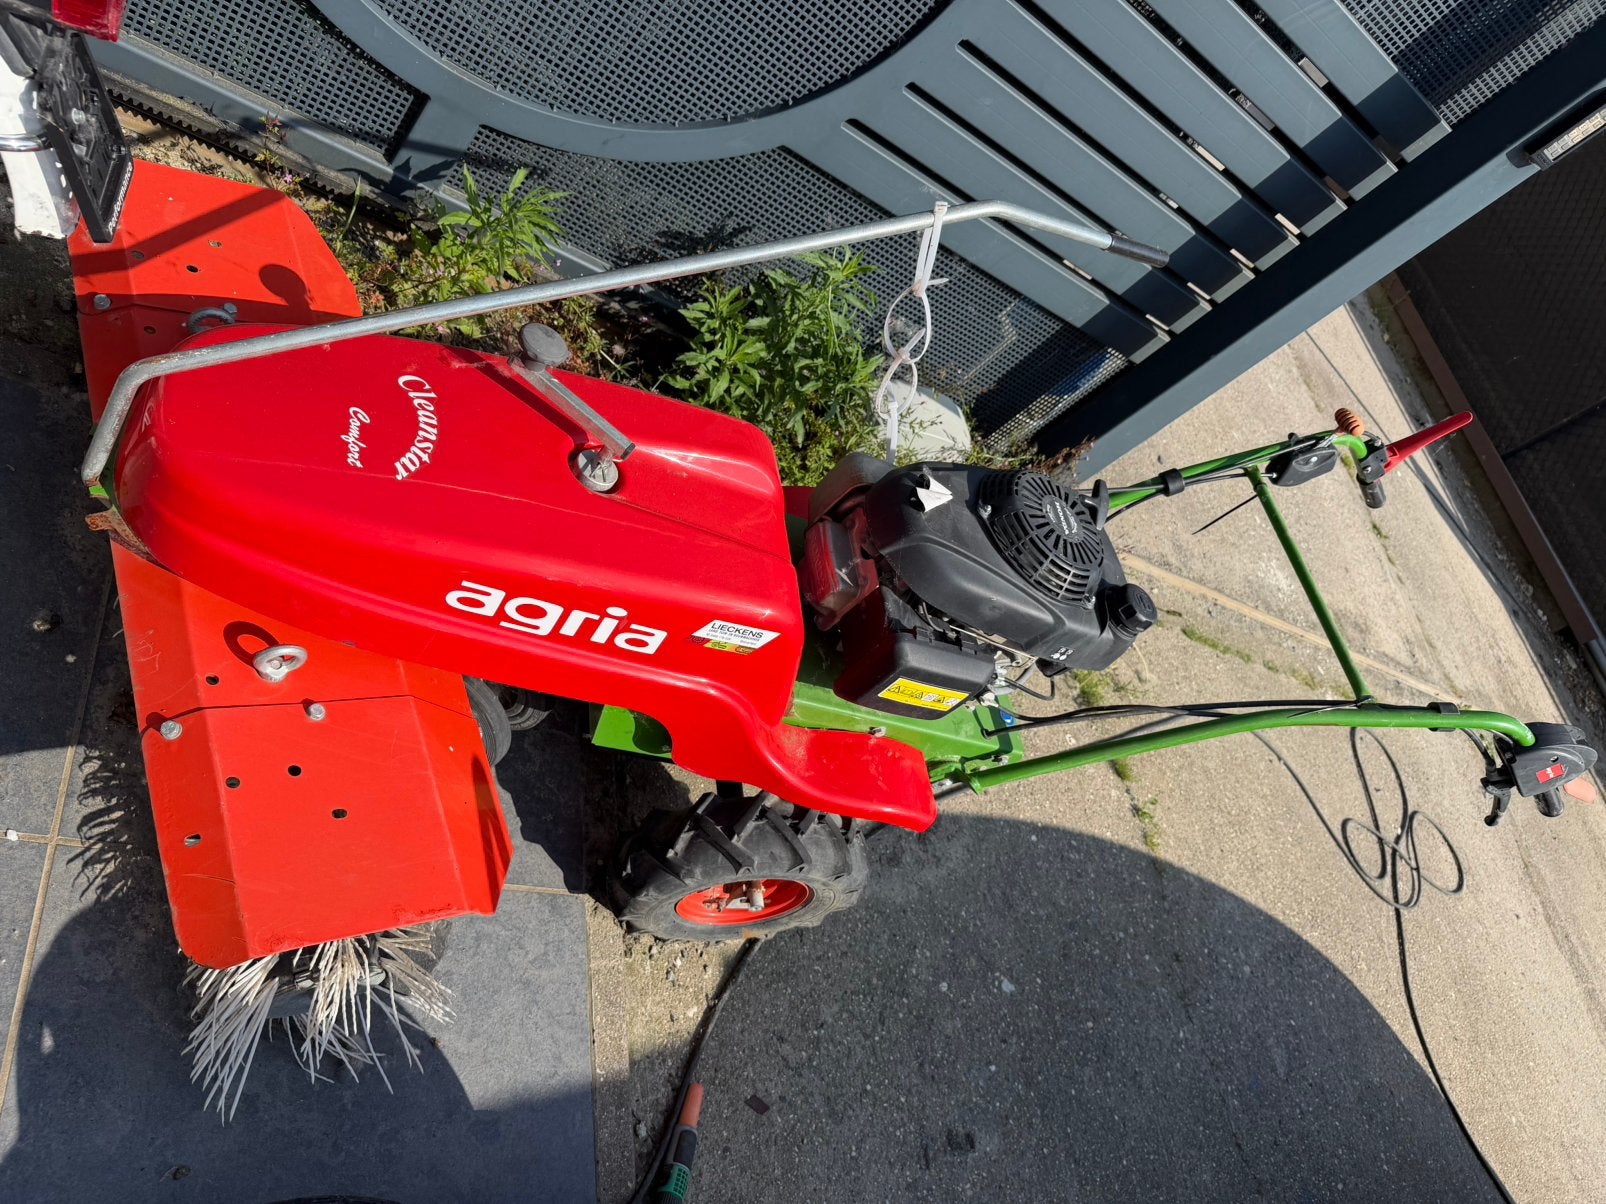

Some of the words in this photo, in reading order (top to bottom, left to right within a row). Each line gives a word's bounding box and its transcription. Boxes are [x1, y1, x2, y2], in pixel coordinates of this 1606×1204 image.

[340, 406, 371, 469] Comfort
[445, 580, 668, 655] agria
[710, 622, 764, 639] LIECKENS
